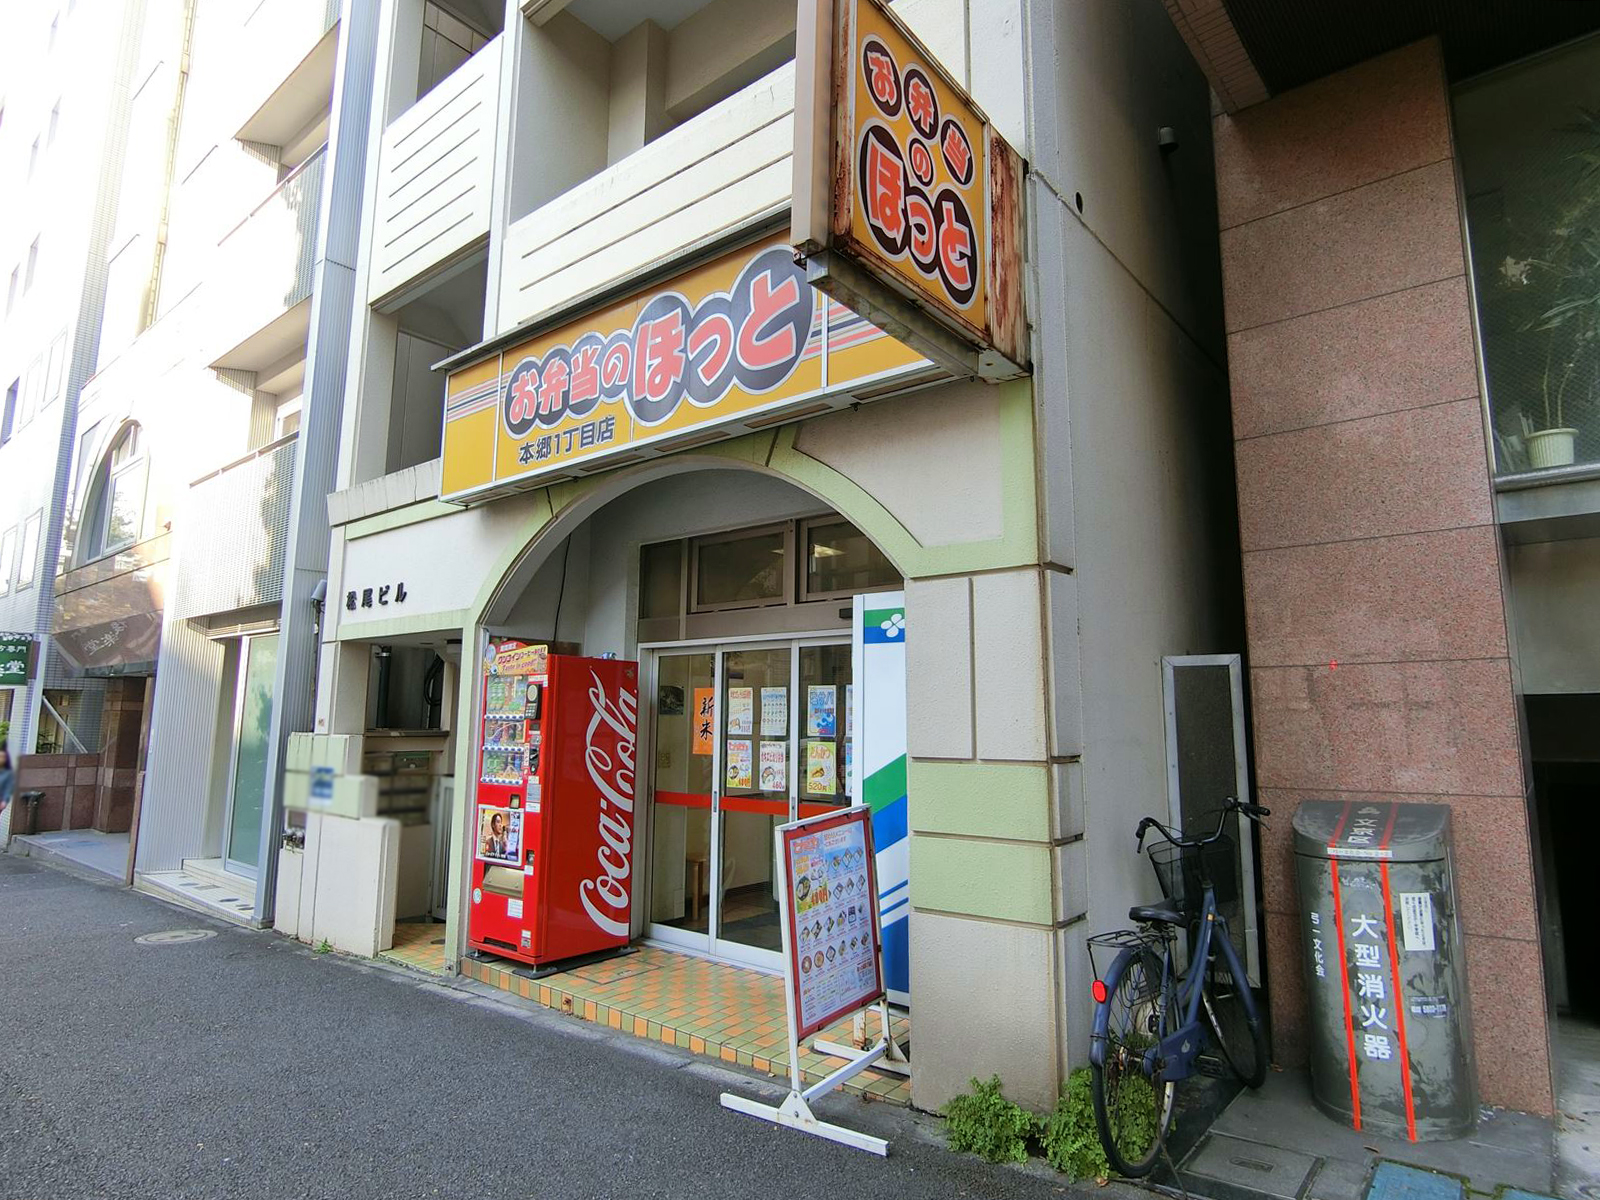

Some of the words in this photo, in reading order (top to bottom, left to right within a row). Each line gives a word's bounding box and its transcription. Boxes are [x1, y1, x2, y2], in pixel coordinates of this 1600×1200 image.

[865, 130, 972, 291] ほっと
[519, 415, 616, 465] 本郷1丁目店
[700, 697, 714, 740] 新米
[580, 667, 637, 936] Coca-Cola
[1347, 818, 1378, 844] 文京区
[1351, 914, 1392, 1060] 大型消火器
